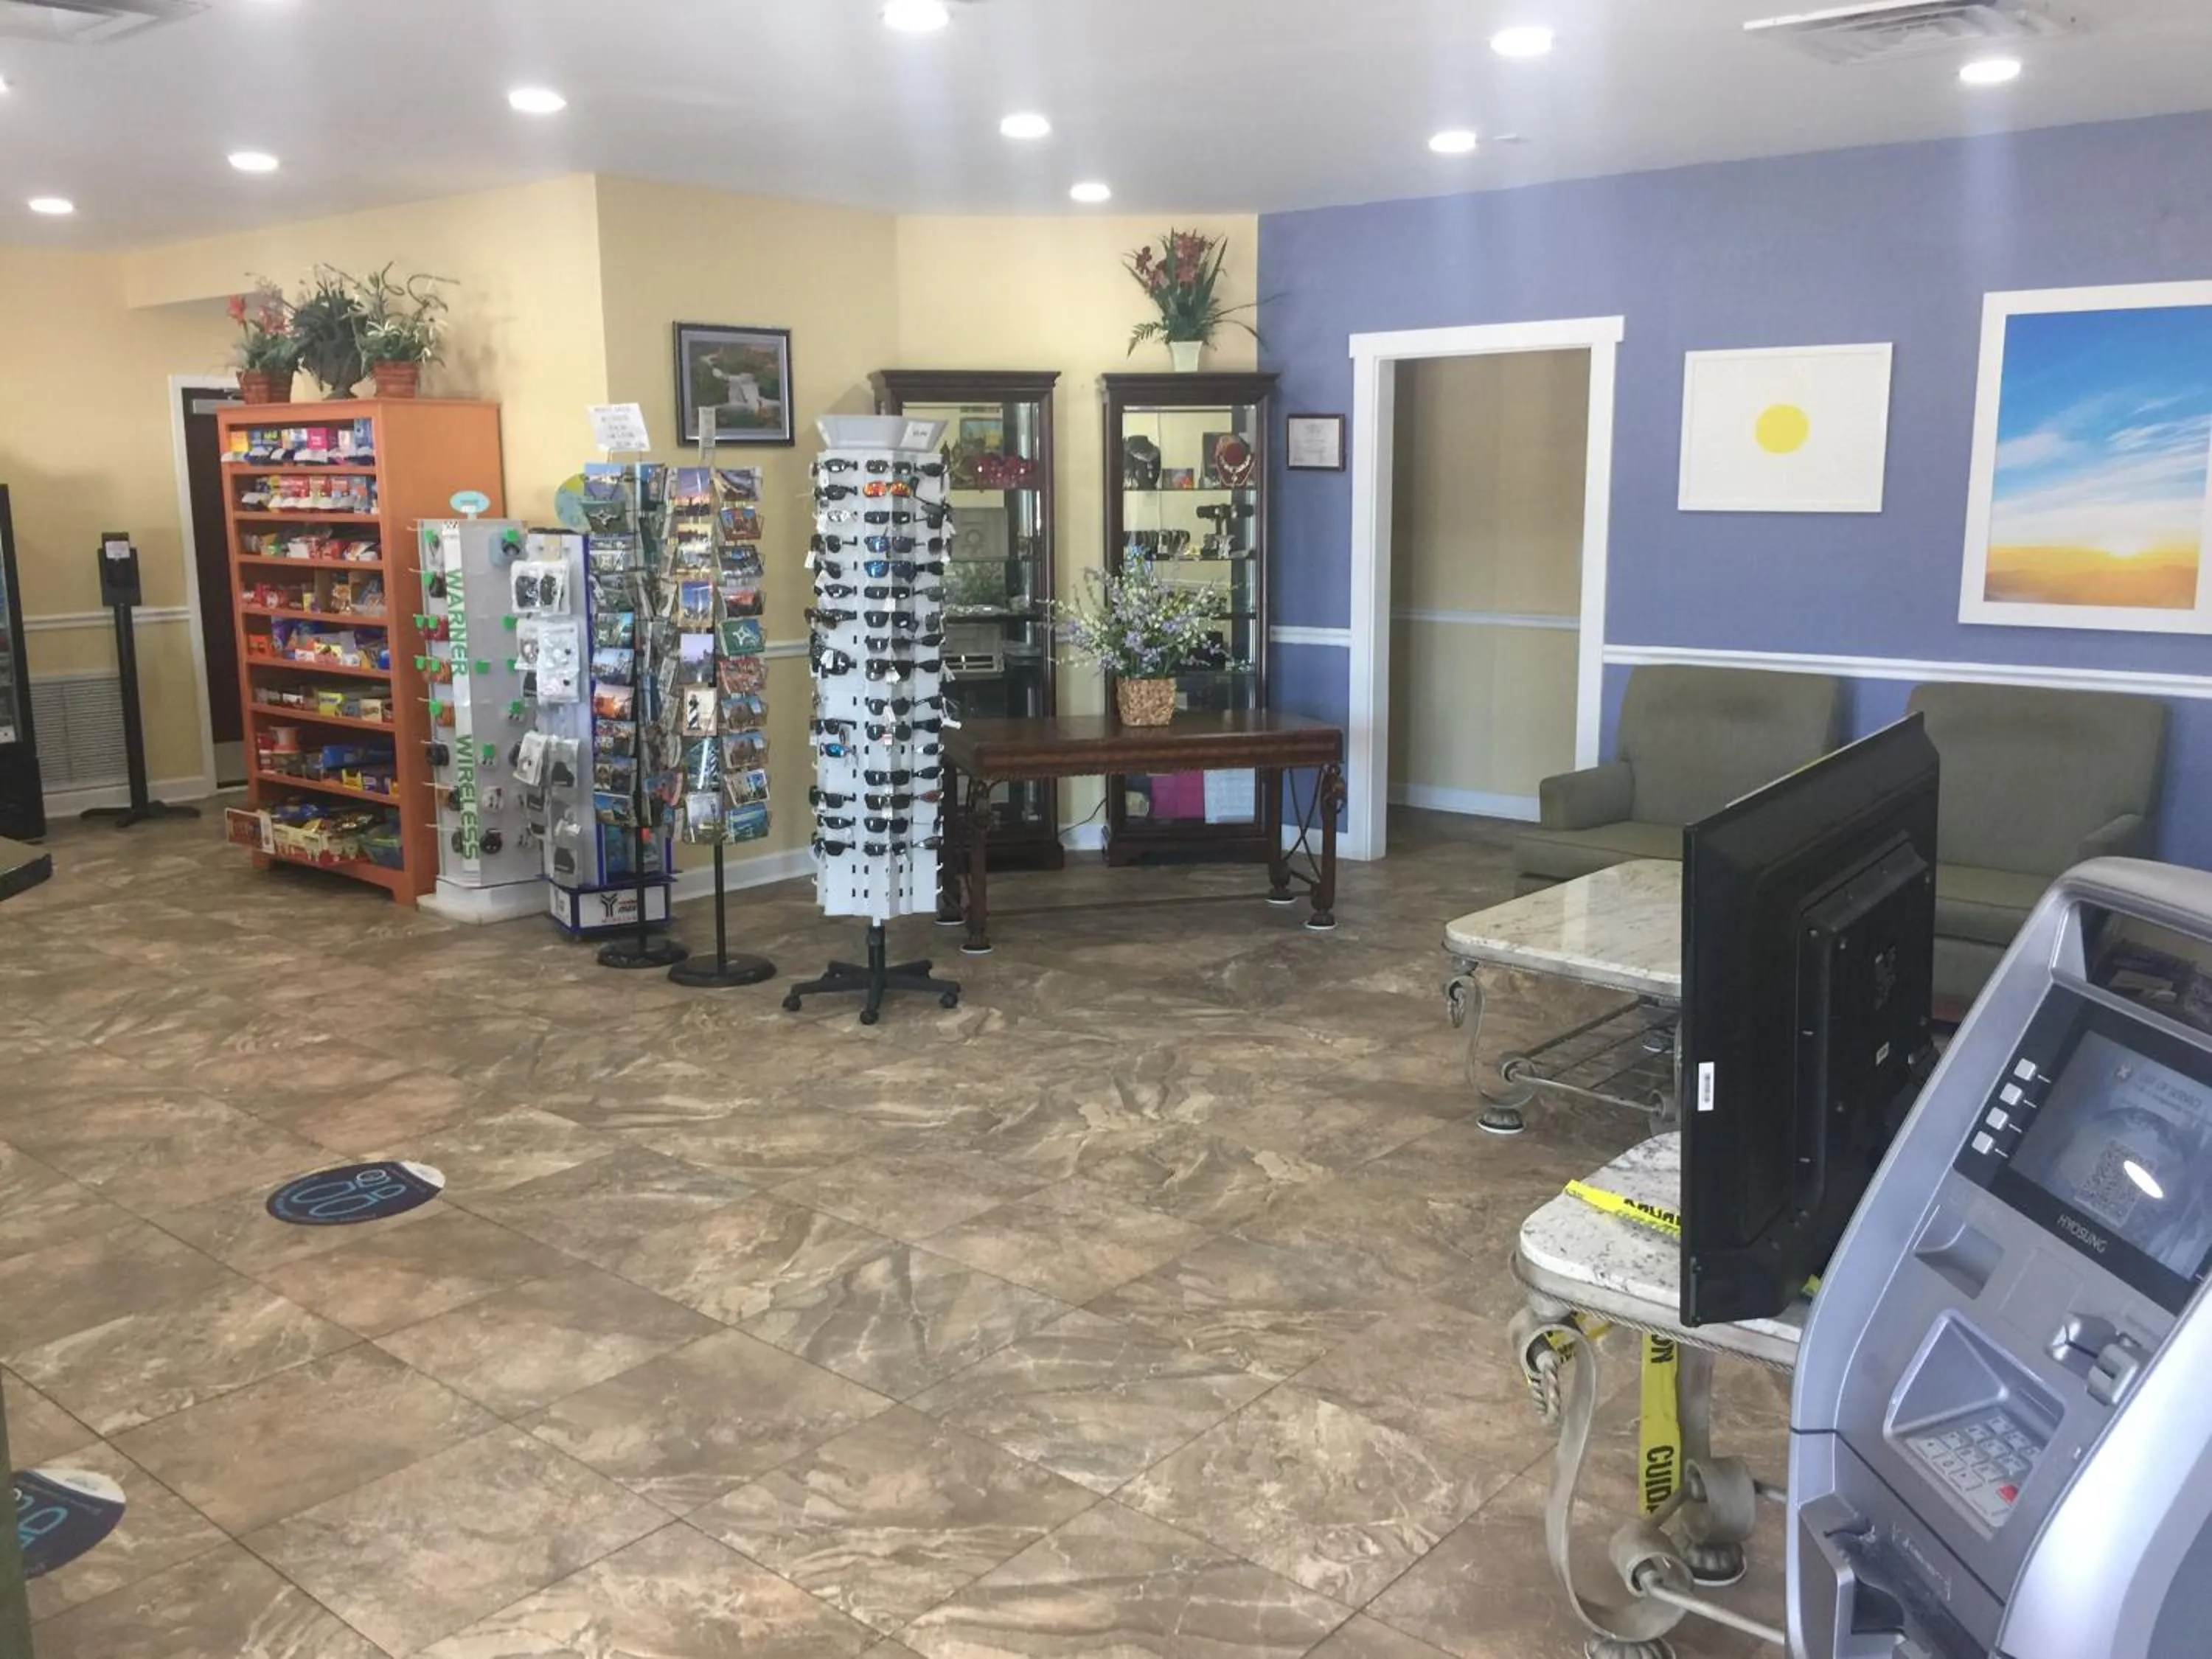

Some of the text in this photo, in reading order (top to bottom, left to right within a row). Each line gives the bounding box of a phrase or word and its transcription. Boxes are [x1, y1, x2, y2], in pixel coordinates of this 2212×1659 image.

[445, 568, 479, 859] WARNER WIRELESS
[2056, 1214, 2109, 1253] HYOSUNG
